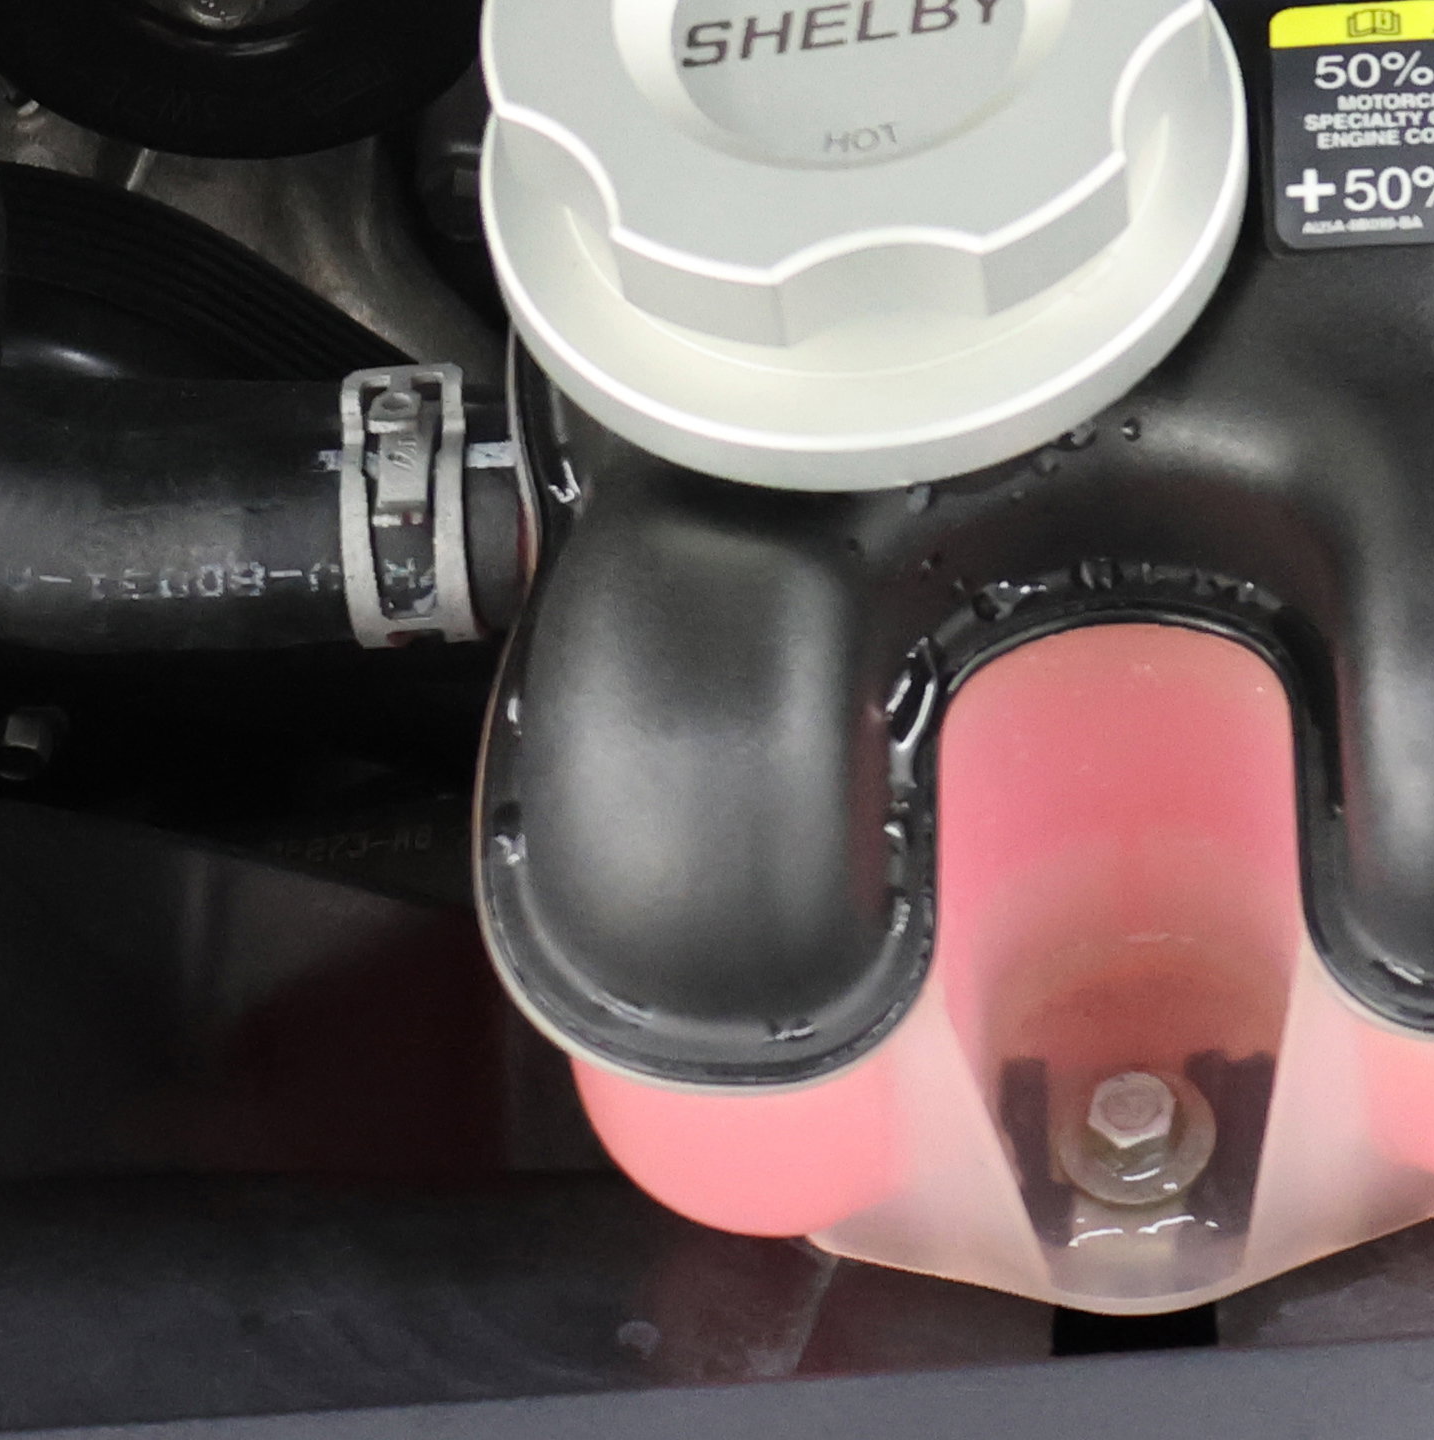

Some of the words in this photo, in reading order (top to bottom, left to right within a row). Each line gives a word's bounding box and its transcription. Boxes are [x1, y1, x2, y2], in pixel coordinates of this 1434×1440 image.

[1313, 49, 1434, 90] 50%
[1303, 111, 1424, 132] SPECIALTY
[822, 122, 899, 154] HOT
[1316, 128, 1401, 150] ENGINE
